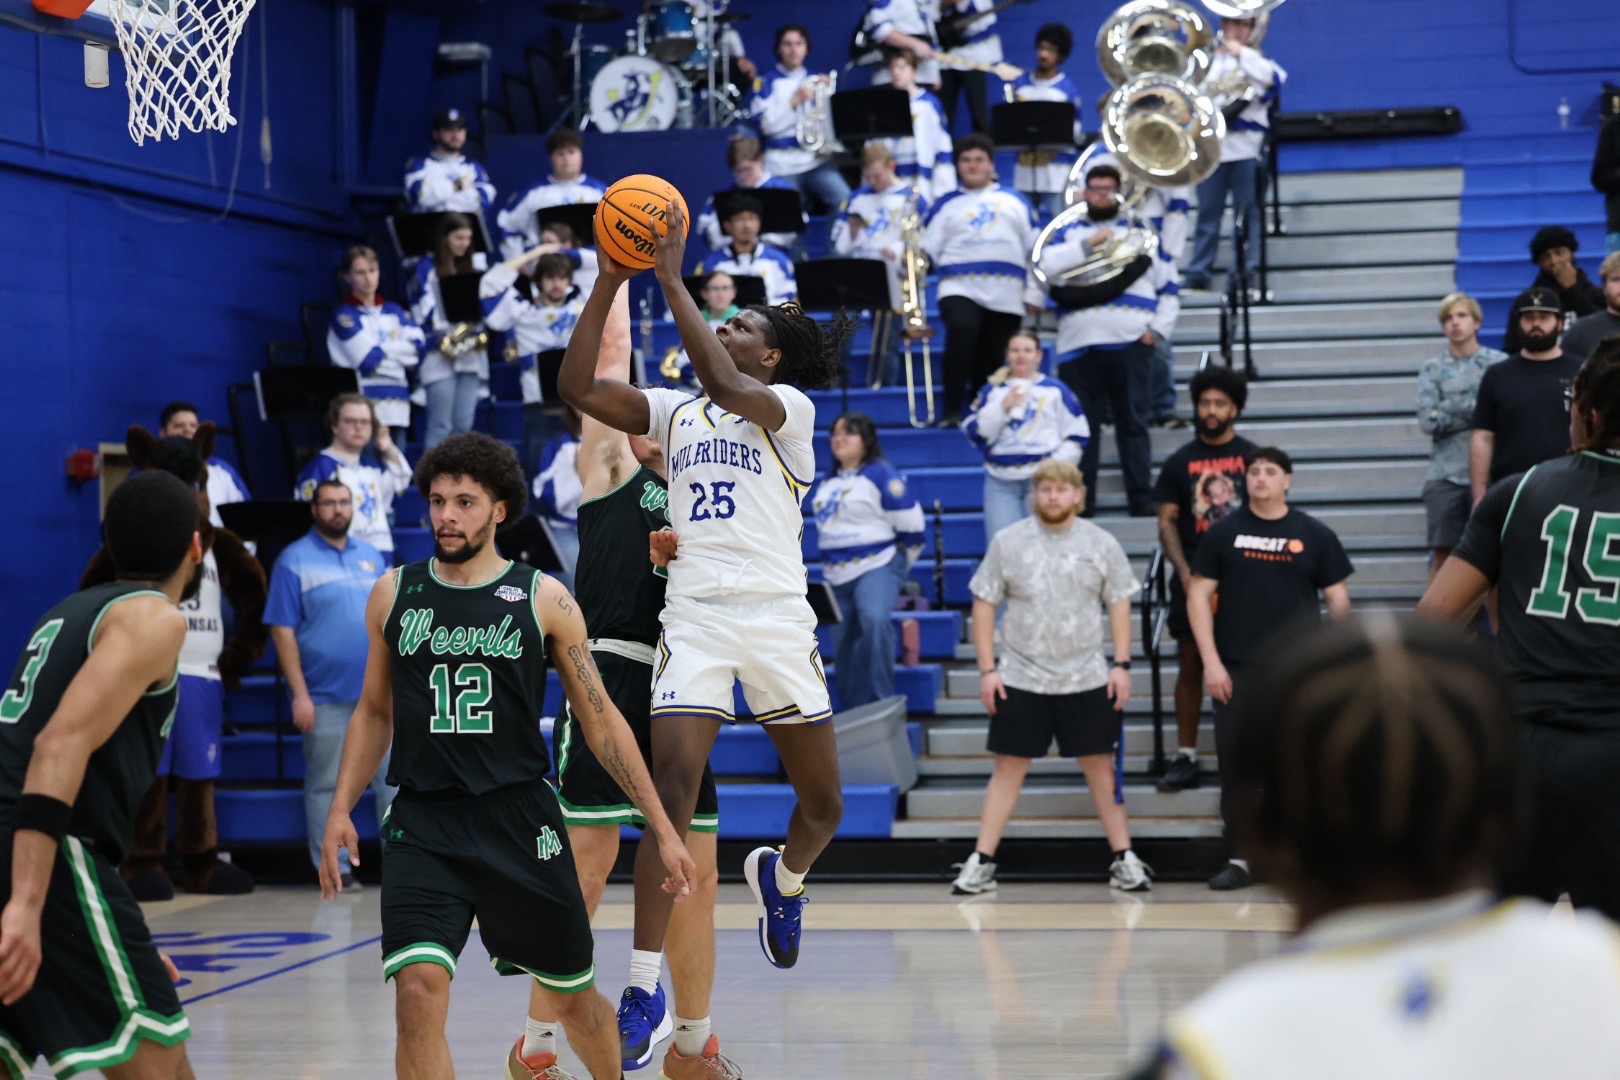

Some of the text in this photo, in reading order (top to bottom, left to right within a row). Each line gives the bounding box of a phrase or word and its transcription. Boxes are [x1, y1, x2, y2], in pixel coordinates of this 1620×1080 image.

[615, 218, 656, 259] ilson
[689, 481, 736, 521] 25
[1526, 504, 1620, 626] 15
[399, 608, 523, 659] Weevils
[0, 618, 64, 723] 3
[429, 663, 493, 733] 12
